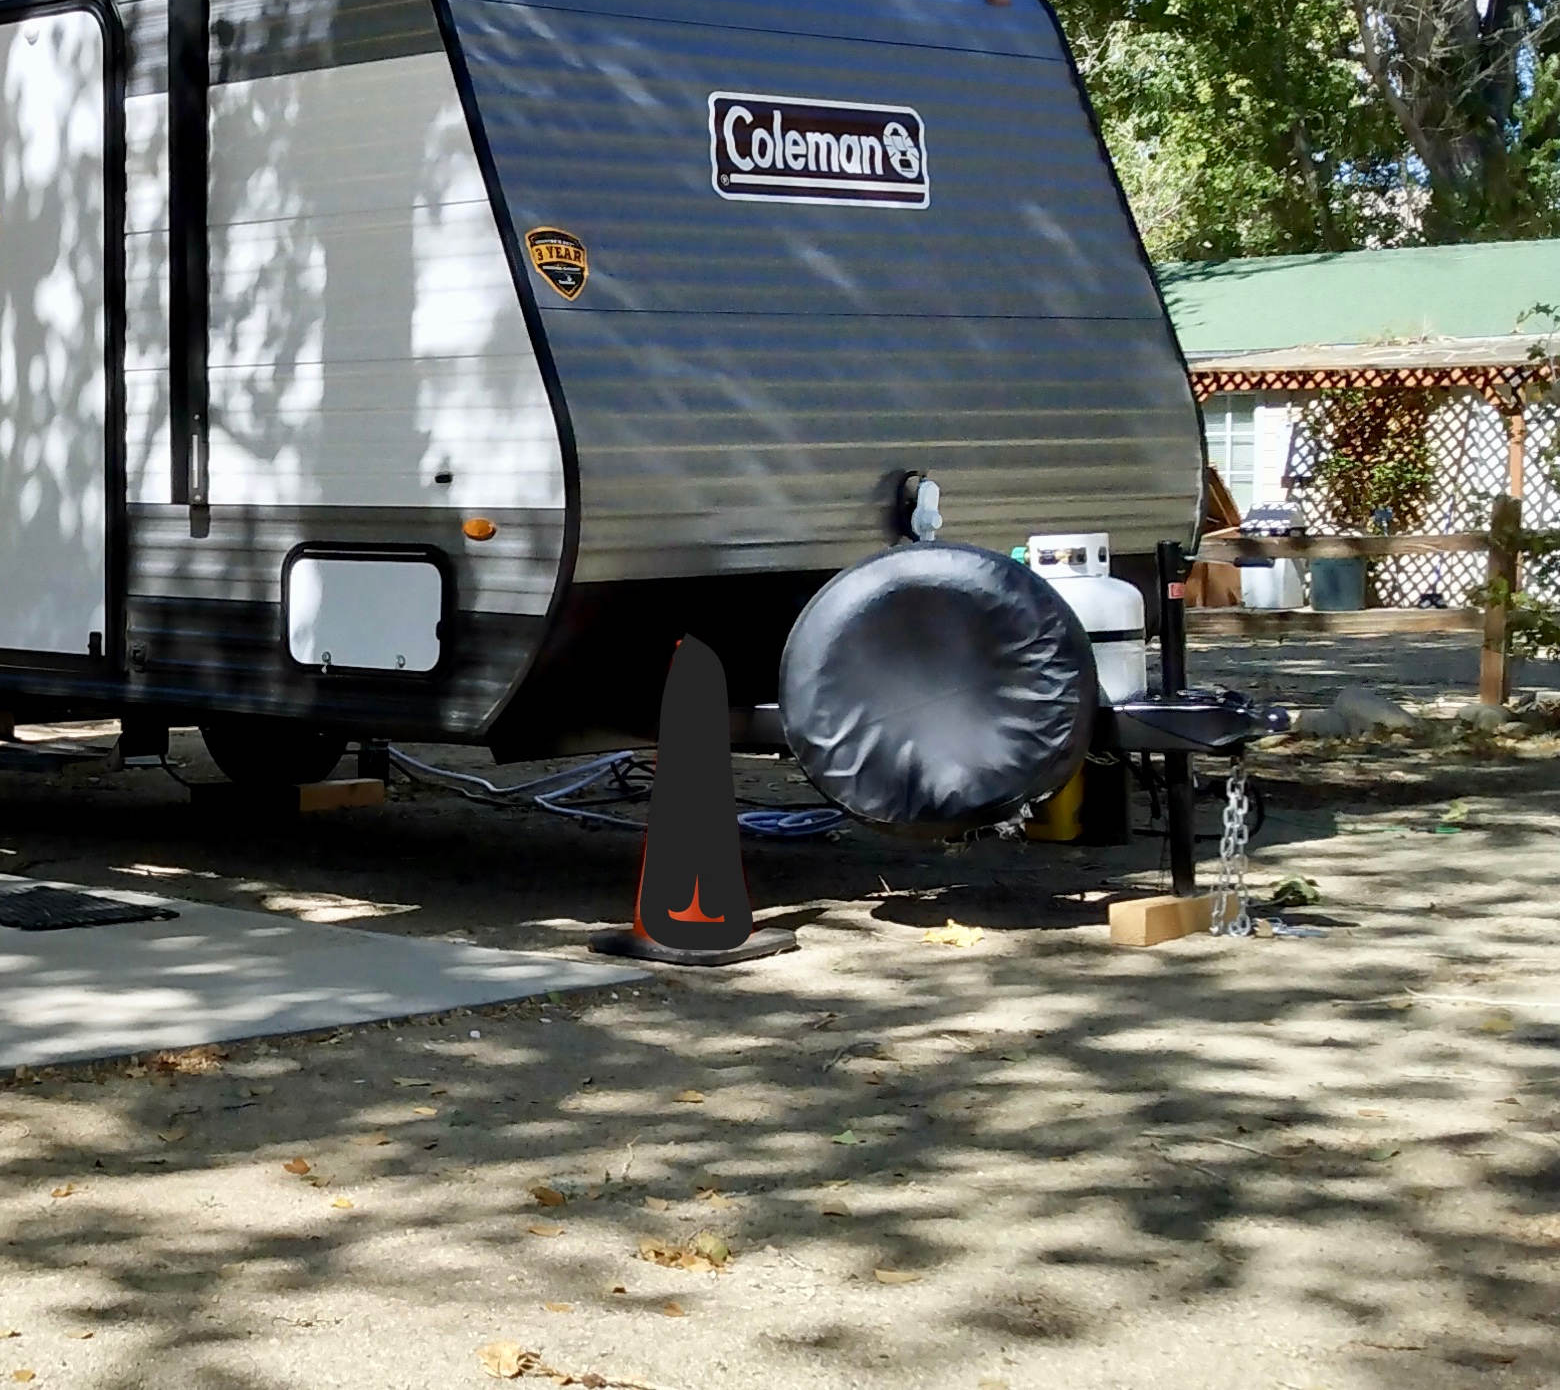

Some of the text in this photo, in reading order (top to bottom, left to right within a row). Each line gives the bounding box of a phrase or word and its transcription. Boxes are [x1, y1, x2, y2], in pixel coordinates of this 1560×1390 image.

[723, 105, 884, 175] Coleman
[536, 246, 582, 263] 3 YEAR
